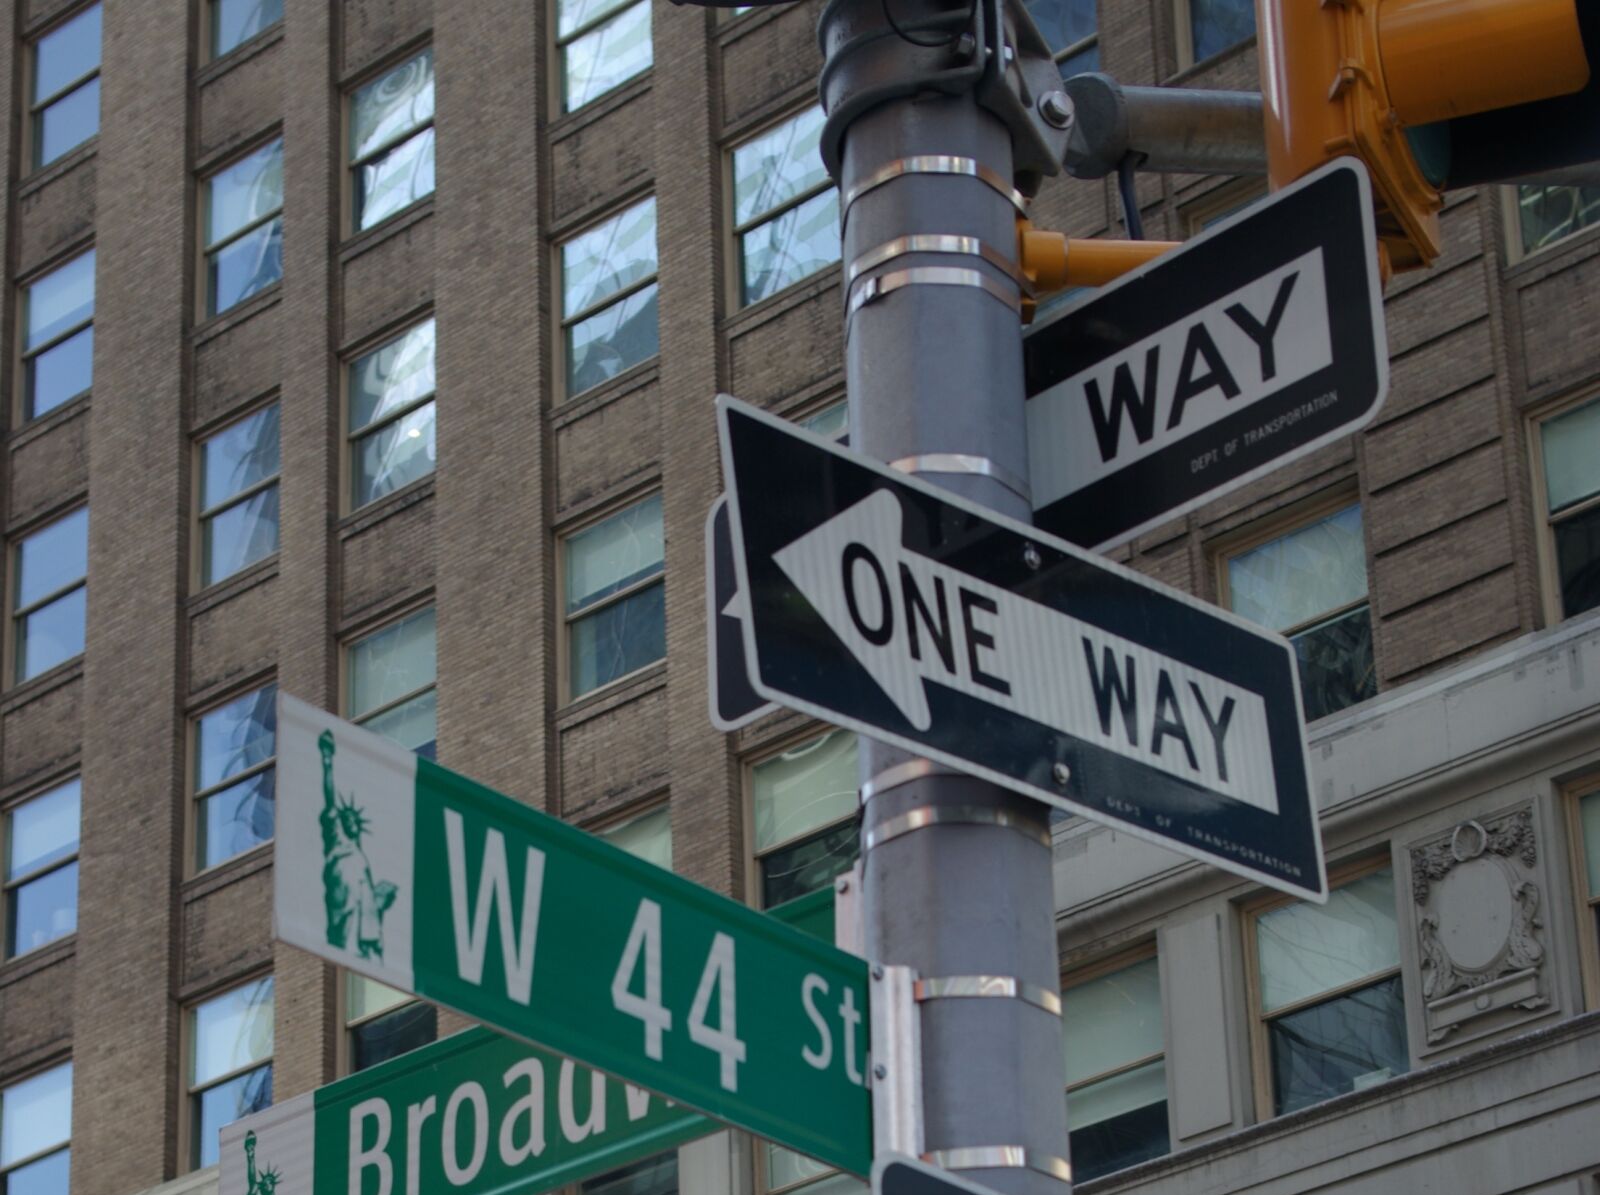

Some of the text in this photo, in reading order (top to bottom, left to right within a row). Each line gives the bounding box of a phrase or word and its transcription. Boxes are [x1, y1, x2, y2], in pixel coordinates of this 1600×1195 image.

[1084, 270, 1301, 463] WAY
[1224, 438, 1239, 456] OF
[1243, 390, 1338, 446] TRANSPORTATION
[841, 542, 1236, 783] ONE WAY
[1154, 814, 1172, 828] OF
[1187, 826, 1302, 878] TRANSPORTATION
[443, 807, 864, 1093] W 44 St
